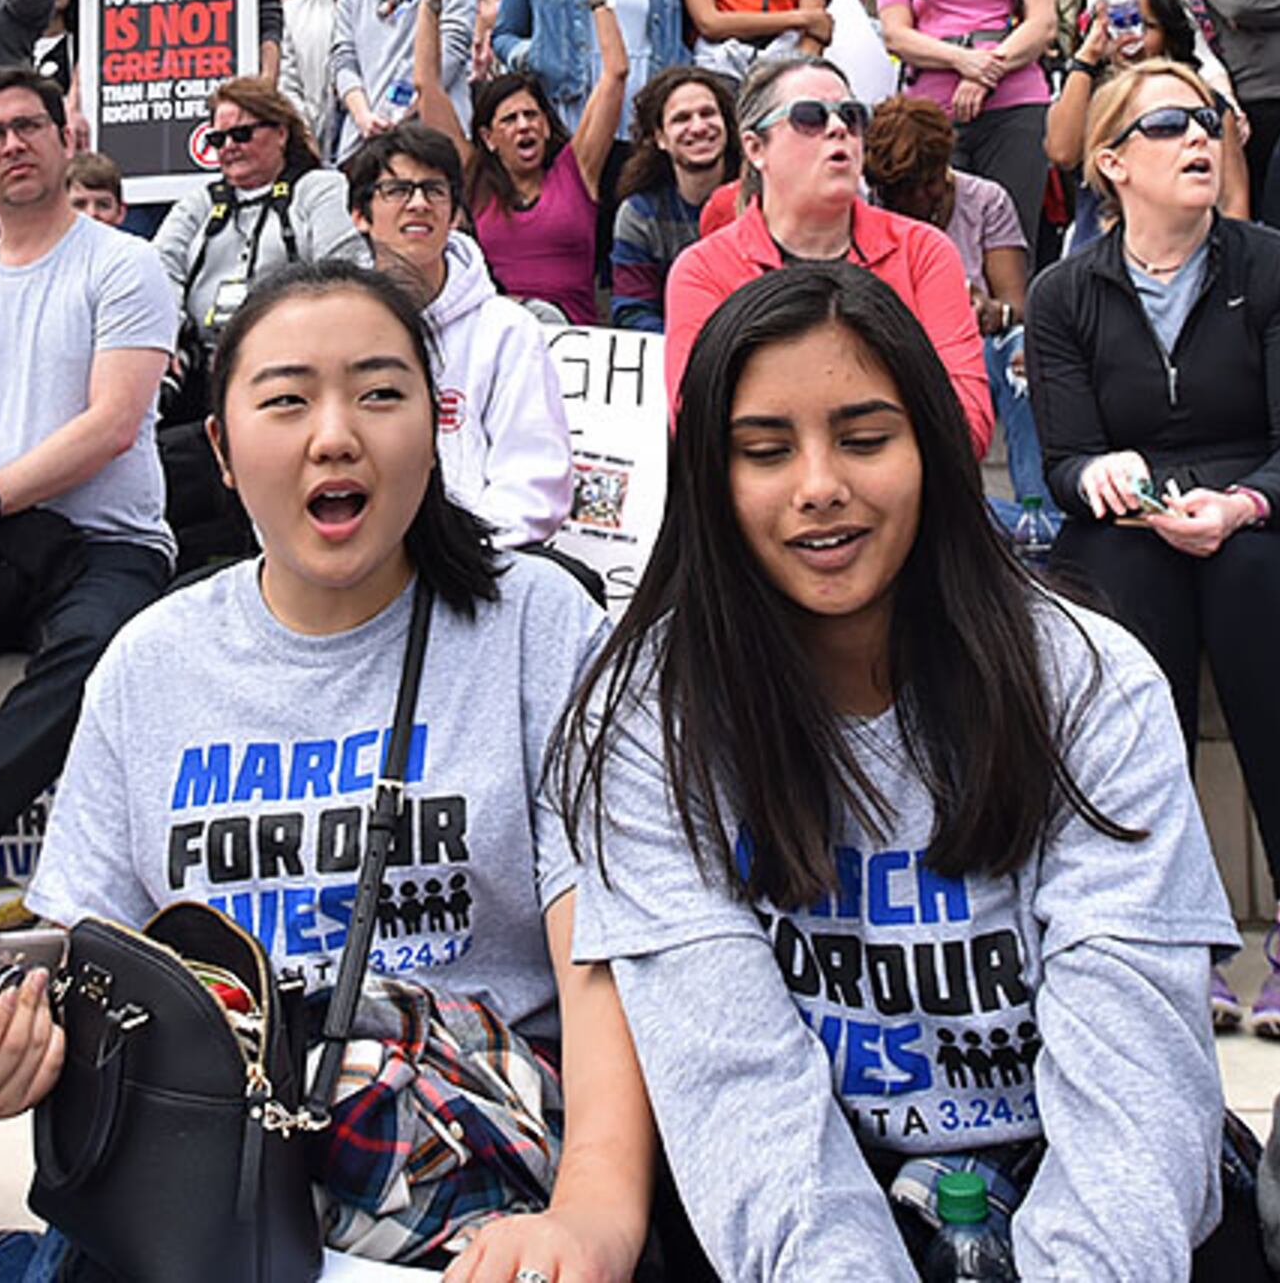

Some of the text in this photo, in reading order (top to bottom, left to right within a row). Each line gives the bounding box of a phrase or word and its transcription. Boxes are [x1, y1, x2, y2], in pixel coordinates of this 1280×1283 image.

[104, 0, 233, 51] IS NOT
[102, 46, 232, 83] GREATER
[102, 84, 142, 102] THAN
[147, 81, 172, 99] MY
[102, 103, 149, 123] RIGHT
[152, 101, 173, 120] TO
[548, 329, 647, 406] GH
[168, 813, 305, 891] FOR
[736, 834, 971, 925] RCH
[756, 910, 1034, 1017] OR OUR
[939, 1093, 1039, 1132] 3.24.1
